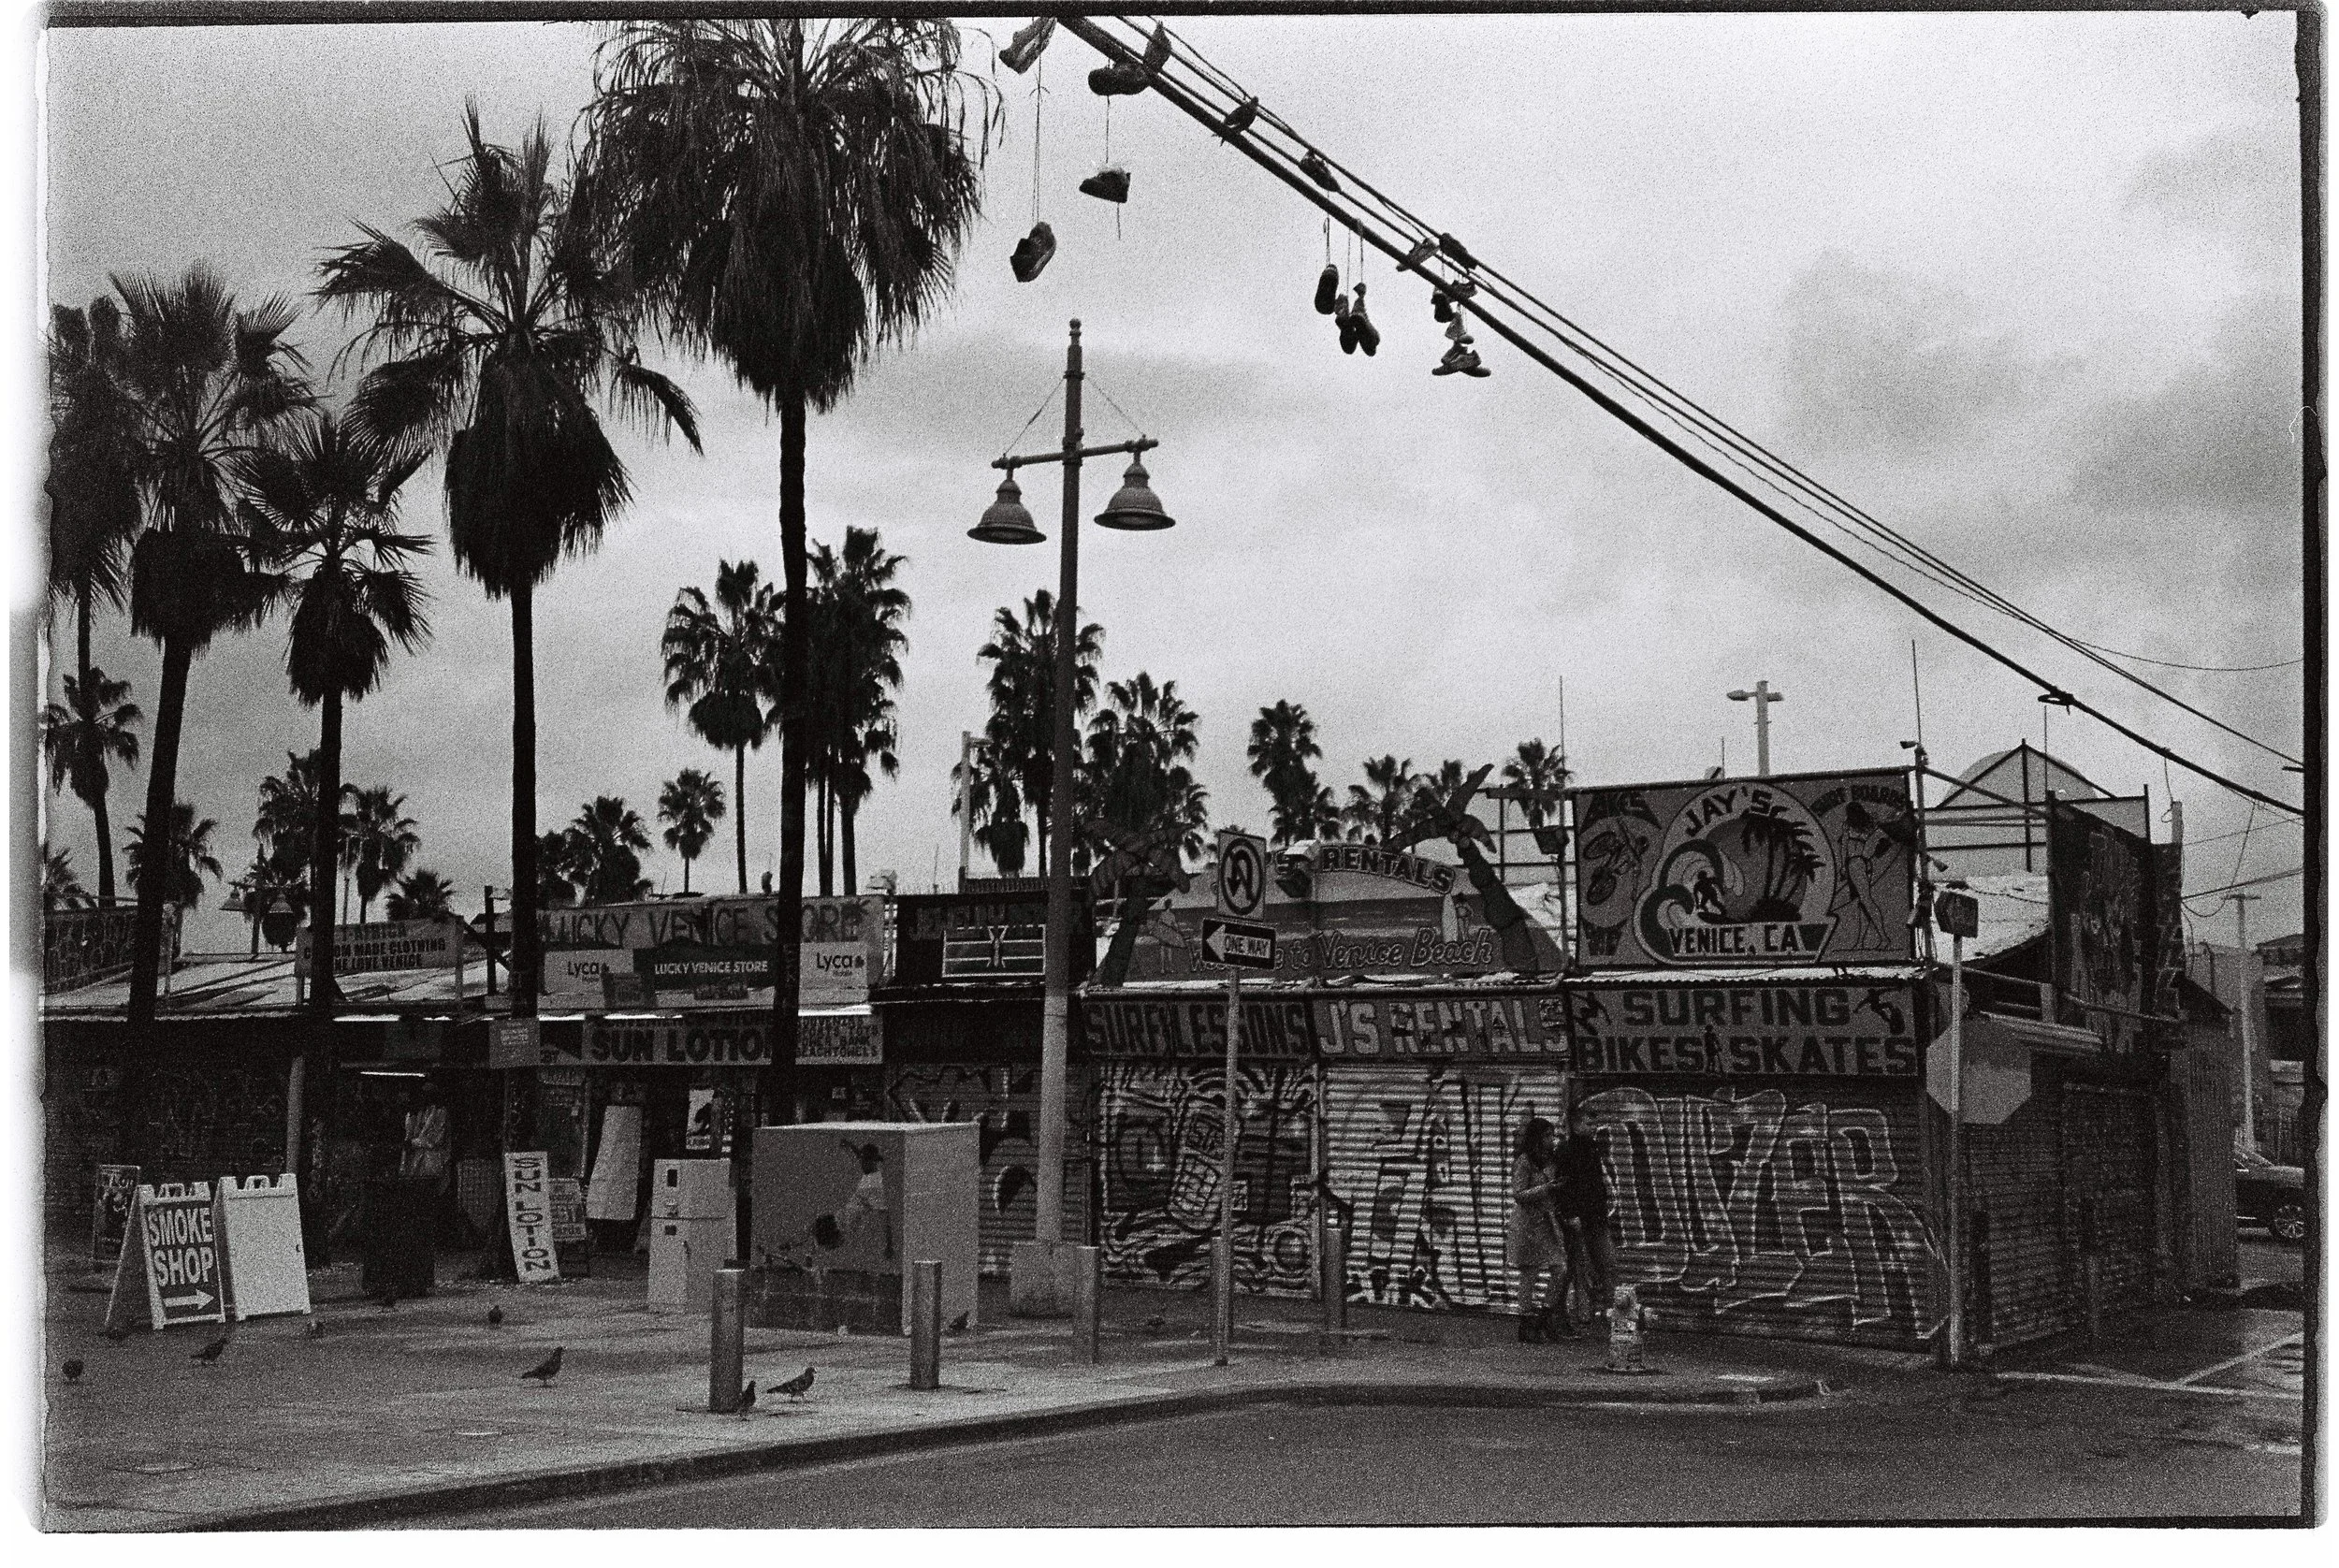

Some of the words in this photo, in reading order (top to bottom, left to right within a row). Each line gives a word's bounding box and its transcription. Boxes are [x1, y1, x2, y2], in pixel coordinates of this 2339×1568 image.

[1684, 784, 1774, 837] JAY'S
[1321, 844, 1456, 894] RENTALS
[764, 903, 860, 942] SORE
[1668, 924, 1757, 955] VENICE,
[1764, 924, 1798, 954] CA
[303, 944, 351, 960] COM
[389, 938, 446, 954] CLOTHING
[381, 954, 422, 968] VENICE
[816, 952, 853, 972] Lyca
[1225, 936, 1245, 953] ONE
[1247, 938, 1271, 957] WAY
[1319, 929, 1402, 968] Venice
[1410, 926, 1493, 966] Beach
[568, 961, 600, 978] Lyca
[655, 962, 690, 975] LUCKY
[691, 961, 731, 974] VENICE
[734, 960, 768, 973] STORE
[1319, 998, 1380, 1054] J'S
[1388, 997, 1569, 1053] RENTALS
[1622, 988, 1852, 1027] SURFING
[591, 1029, 654, 1062] SUN
[1086, 1002, 1167, 1054] SURF
[1577, 1036, 1705, 1073] BIKES
[1730, 1036, 1918, 1075] SKATES
[512, 1156, 542, 1194] SUN
[148, 1207, 213, 1247] SMOKE
[516, 1201, 552, 1272] LOTION
[153, 1246, 214, 1287] SHOP
